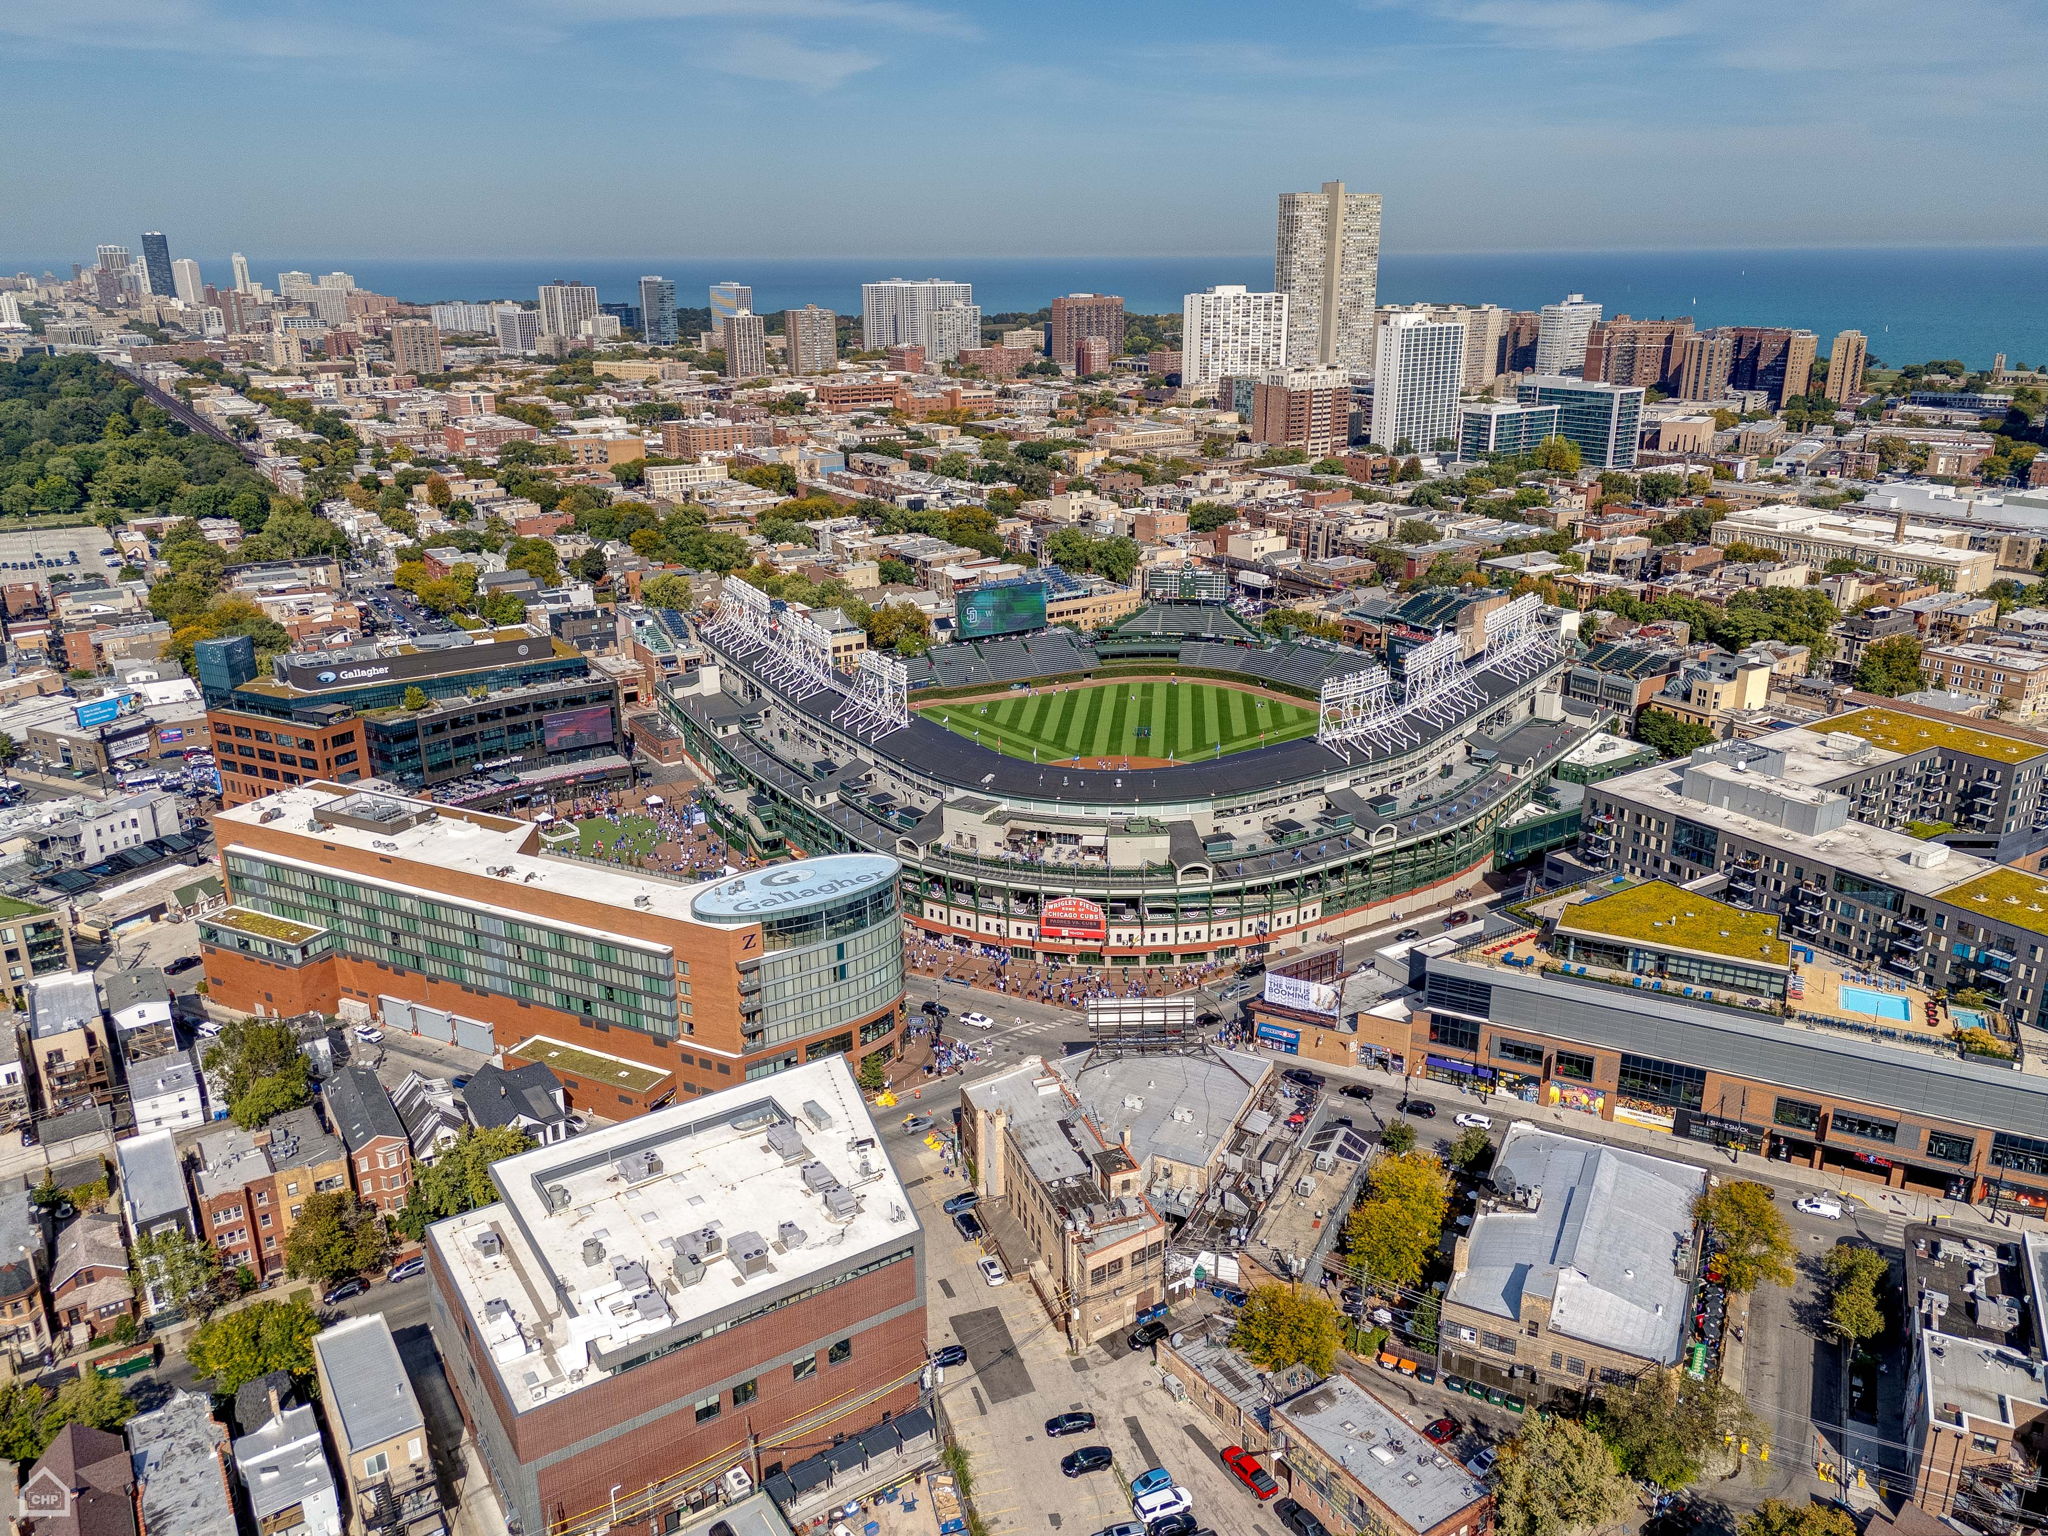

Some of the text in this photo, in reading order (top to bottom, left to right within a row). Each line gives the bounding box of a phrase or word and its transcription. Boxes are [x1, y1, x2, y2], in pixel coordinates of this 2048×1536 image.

[339, 666, 389, 680] Gallagher
[484, 755, 523, 769] Gallagher Way
[733, 870, 885, 912] Gallagher
[1048, 900, 1099, 913] WRIGLEY FIELD
[1048, 911, 1078, 919] CHICAGO
[742, 933, 757, 951] Z
[1268, 981, 1284, 990] THE
[1268, 987, 1310, 1001] BOOMING
